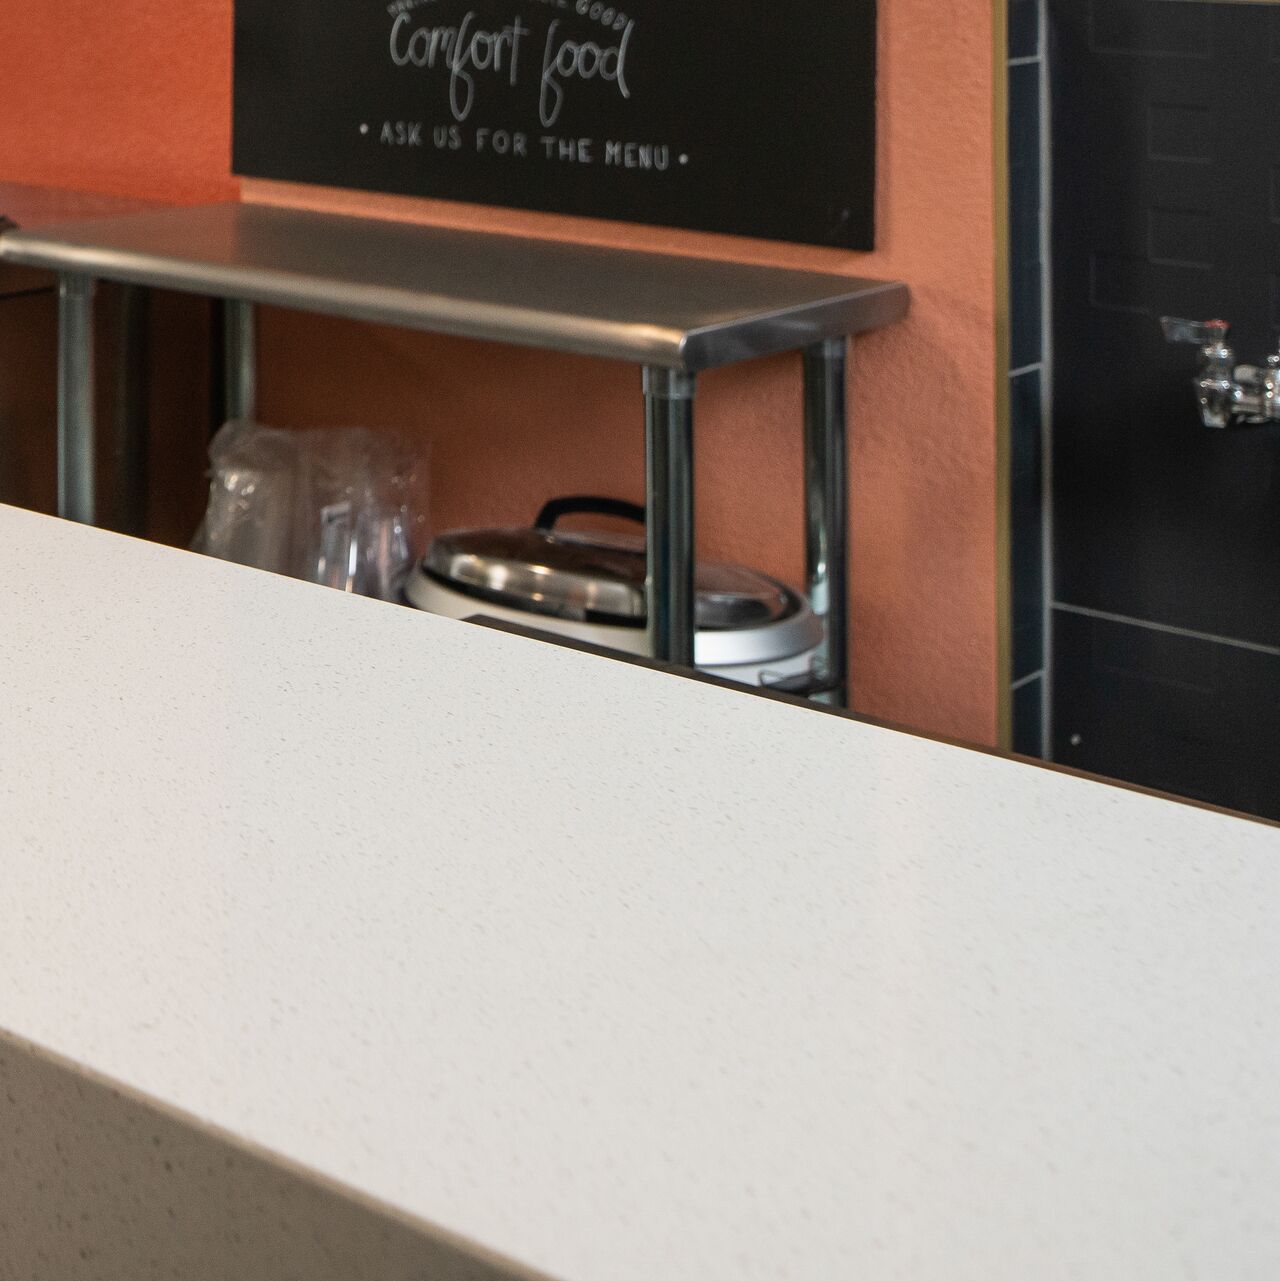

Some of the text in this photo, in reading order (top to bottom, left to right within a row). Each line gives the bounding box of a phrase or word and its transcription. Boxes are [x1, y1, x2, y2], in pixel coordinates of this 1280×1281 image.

[389, 12, 635, 128] Comfort food
[379, 121, 670, 171] ASK US FOR THE MENU
